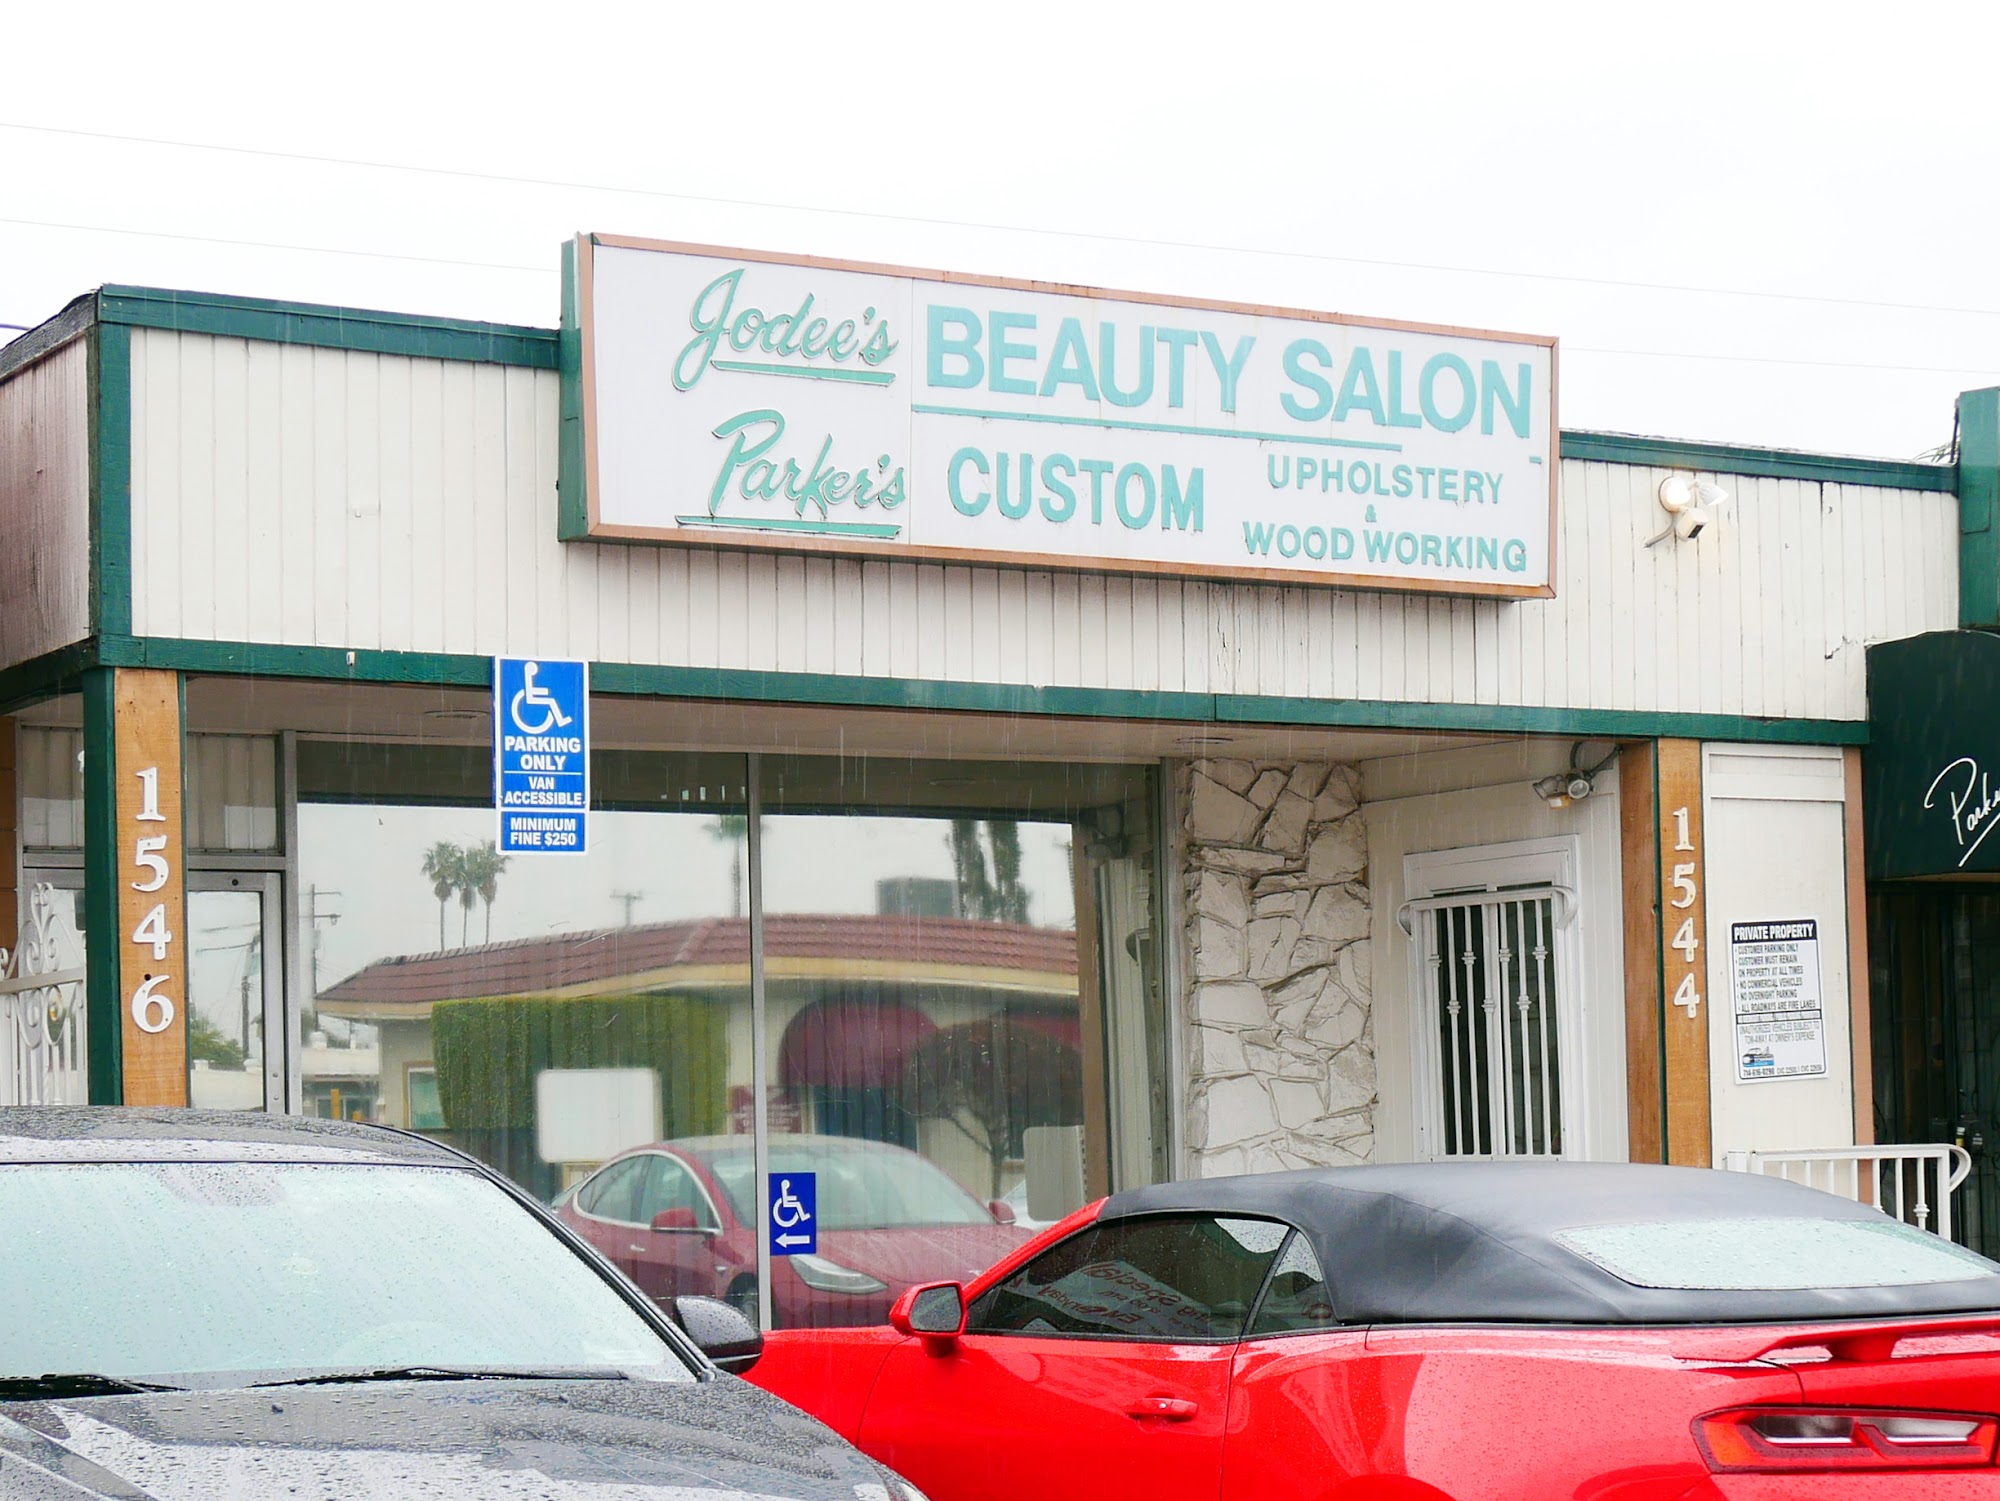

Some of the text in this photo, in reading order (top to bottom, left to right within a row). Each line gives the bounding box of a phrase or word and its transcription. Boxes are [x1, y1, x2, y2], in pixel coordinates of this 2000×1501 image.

[672, 268, 899, 392] Jodee's
[926, 304, 1532, 440] BEAUTY SALON
[711, 408, 907, 518] Parker's
[1267, 453, 1504, 505] UPHOLSTERY
[947, 446, 1205, 533] CUSTOM
[1364, 504, 1378, 523] &
[1242, 520, 1528, 573] WOOD WORKING
[504, 735, 581, 754] PARKING
[520, 754, 567, 771] ONLY
[528, 776, 555, 790] VAN
[504, 791, 582, 806] ACCESSIBLE
[510, 817, 576, 831] MINIMUM
[510, 832, 576, 847] FINE $250
[131, 766, 175, 1034] 1546
[1671, 806, 1700, 1019] 1544
[1734, 923, 1814, 941] PRIVATE PROPERTY
[1738, 943, 1799, 955] CUSTOMER PARKING ONLY
[1738, 954, 1798, 966] CUSTOMER MUST REMAIN
[1746, 967, 1770, 977] PROPERTY
[1771, 966, 1778, 976] AT
[1779, 966, 1788, 975] ALL
[1788, 965, 1804, 975] TIMES
[1740, 977, 1803, 989] NO COMMERCIAL VEHICLES
[1740, 989, 1798, 1000] NO OVERNIGHT PARKING
[1741, 1003, 1750, 1012] ALL
[1788, 1000, 1799, 1009] FIRE
[1800, 999, 1816, 1009] LANES
